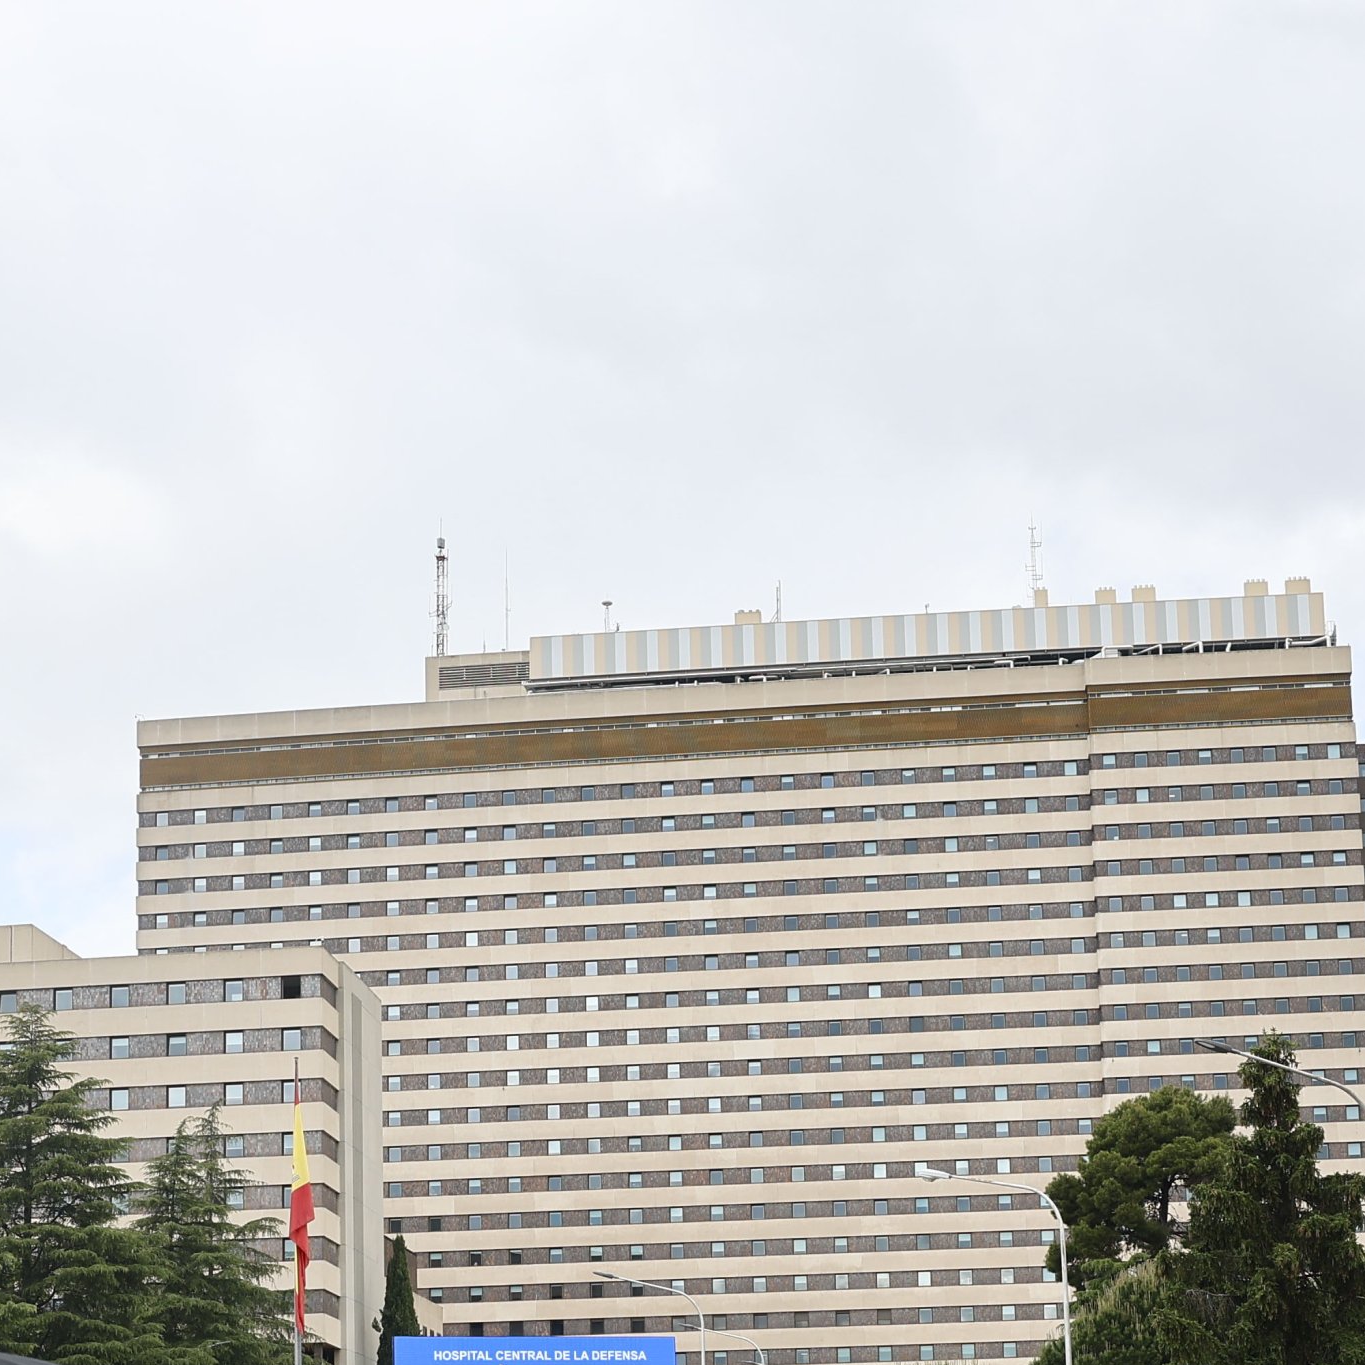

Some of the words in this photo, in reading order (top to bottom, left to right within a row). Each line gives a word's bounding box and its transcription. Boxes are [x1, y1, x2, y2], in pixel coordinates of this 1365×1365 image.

[433, 1350, 492, 1361] HOSPITAL
[495, 1350, 552, 1361] CENTRAL
[555, 1350, 571, 1361] DE
[573, 1350, 590, 1361] LA
[591, 1350, 647, 1361] DEFENSA
